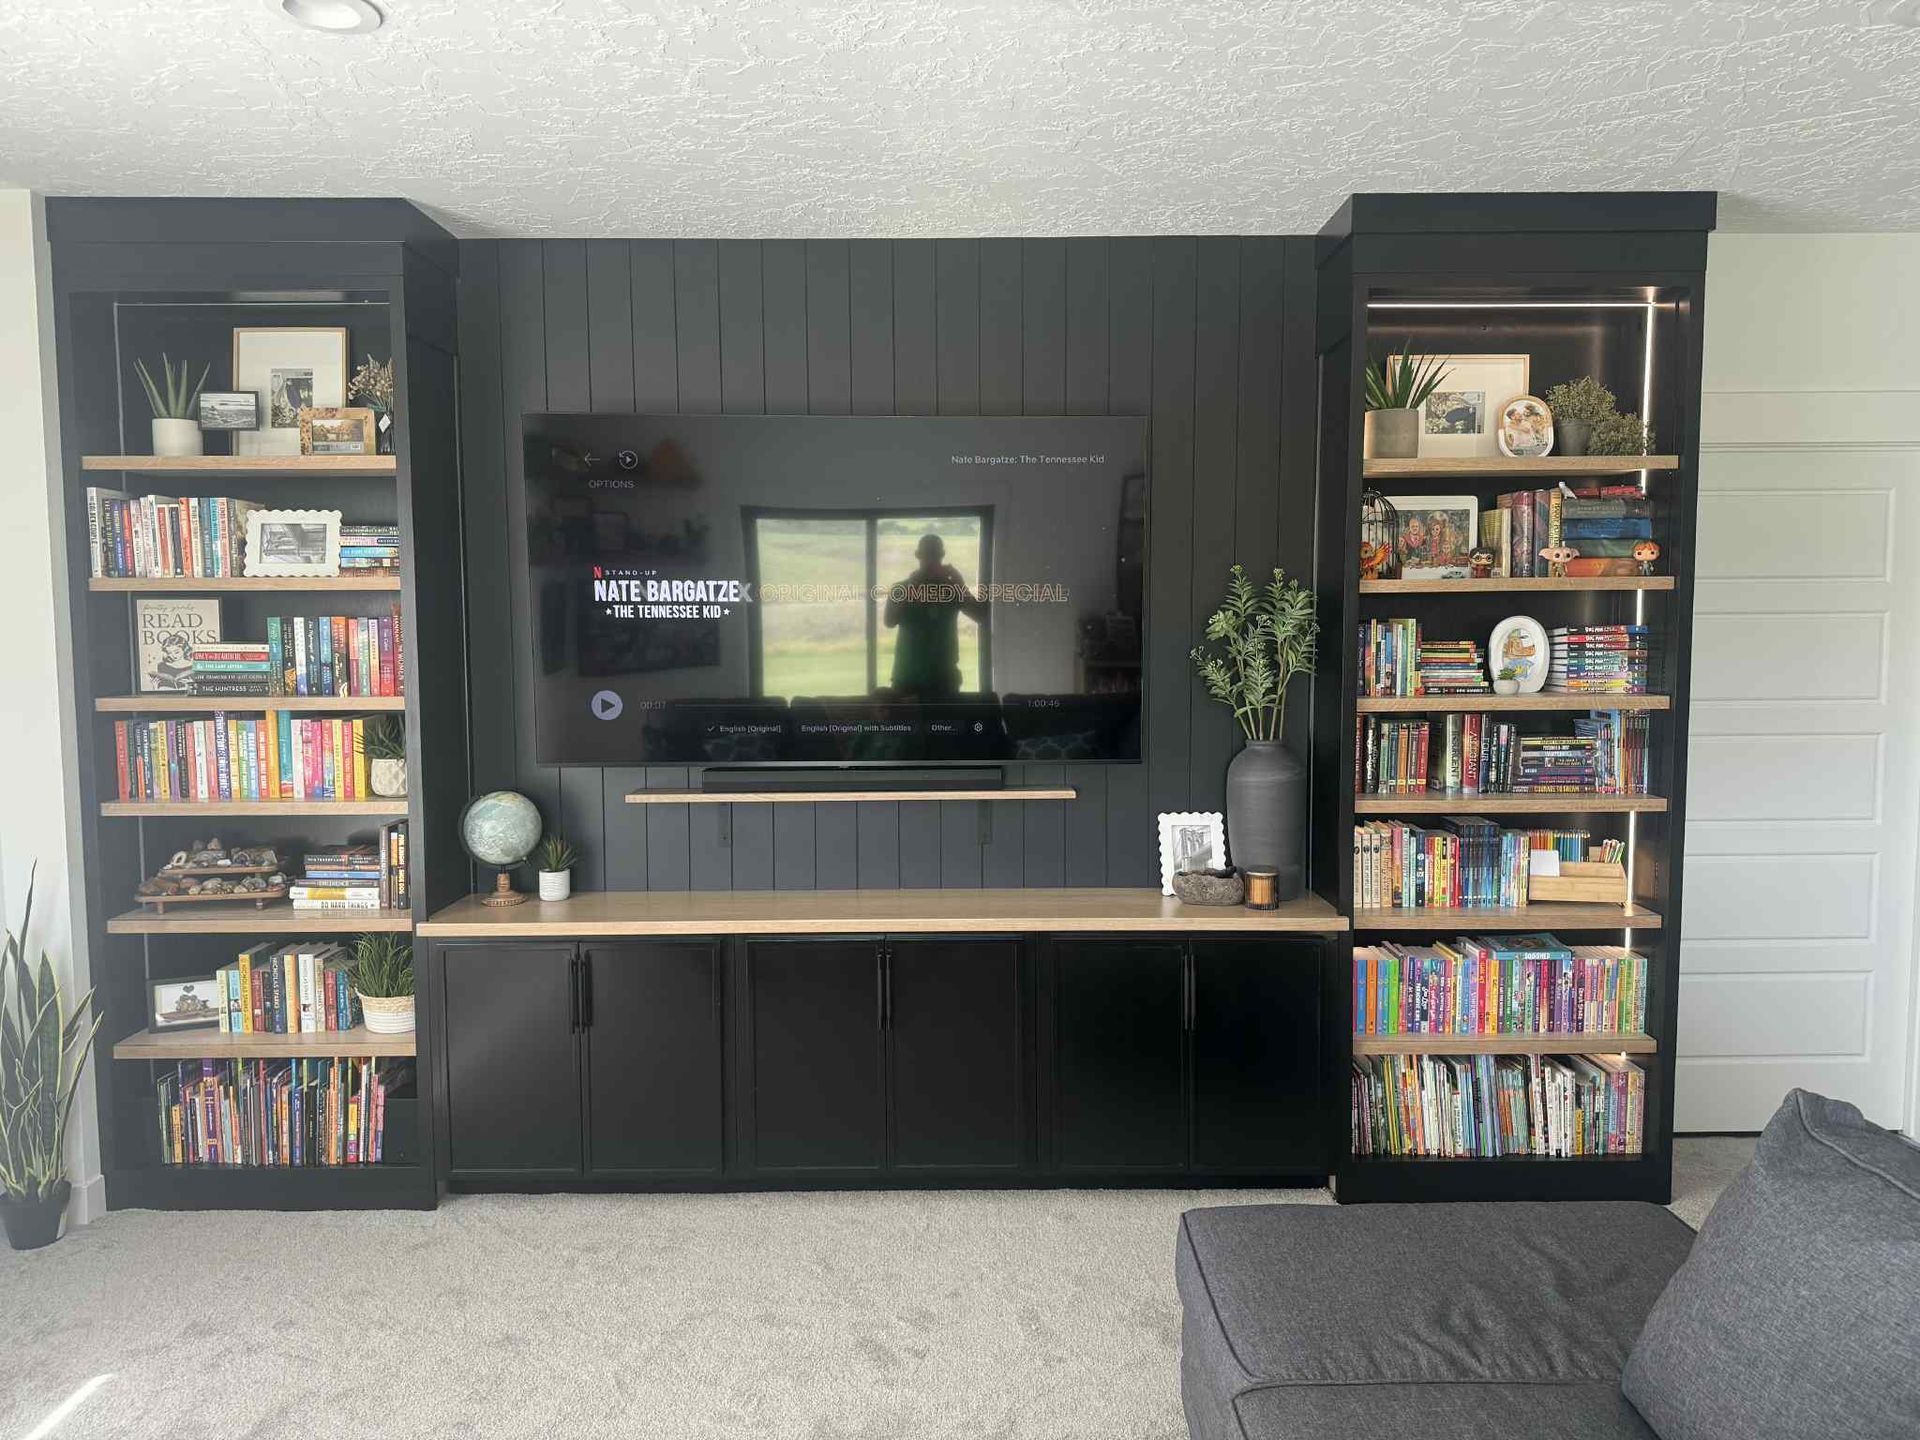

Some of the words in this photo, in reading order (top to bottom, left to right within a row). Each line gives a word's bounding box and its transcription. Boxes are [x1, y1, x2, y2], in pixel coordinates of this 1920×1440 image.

[951, 455, 972, 464] Nate
[975, 455, 1018, 466] Bargatze:
[1020, 455, 1037, 464] The
[1039, 455, 1088, 464] Tennessee
[1089, 454, 1105, 464] Kid
[588, 480, 635, 489] OPTIONS
[593, 579, 641, 602] NATE
[647, 579, 740, 602] BARGATZE
[759, 583, 861, 603] ORIGINAL
[870, 583, 967, 603] COMEDY
[975, 583, 1069, 603] SPECIAL
[613, 605, 635, 618] THE
[637, 605, 700, 618] TENNESSEE
[702, 605, 721, 618] KID
[142, 613, 203, 628] READ
[143, 629, 217, 645] BOOKS
[720, 726, 746, 734] English
[748, 725, 782, 734] [Original]
[801, 724, 828, 733] English
[829, 724, 862, 733] [Original]
[864, 724, 879, 732] with
[880, 724, 912, 732] Subtitles
[1468, 731, 1477, 779] ALLEGIANT
[1481, 738, 1489, 761] FOUR
